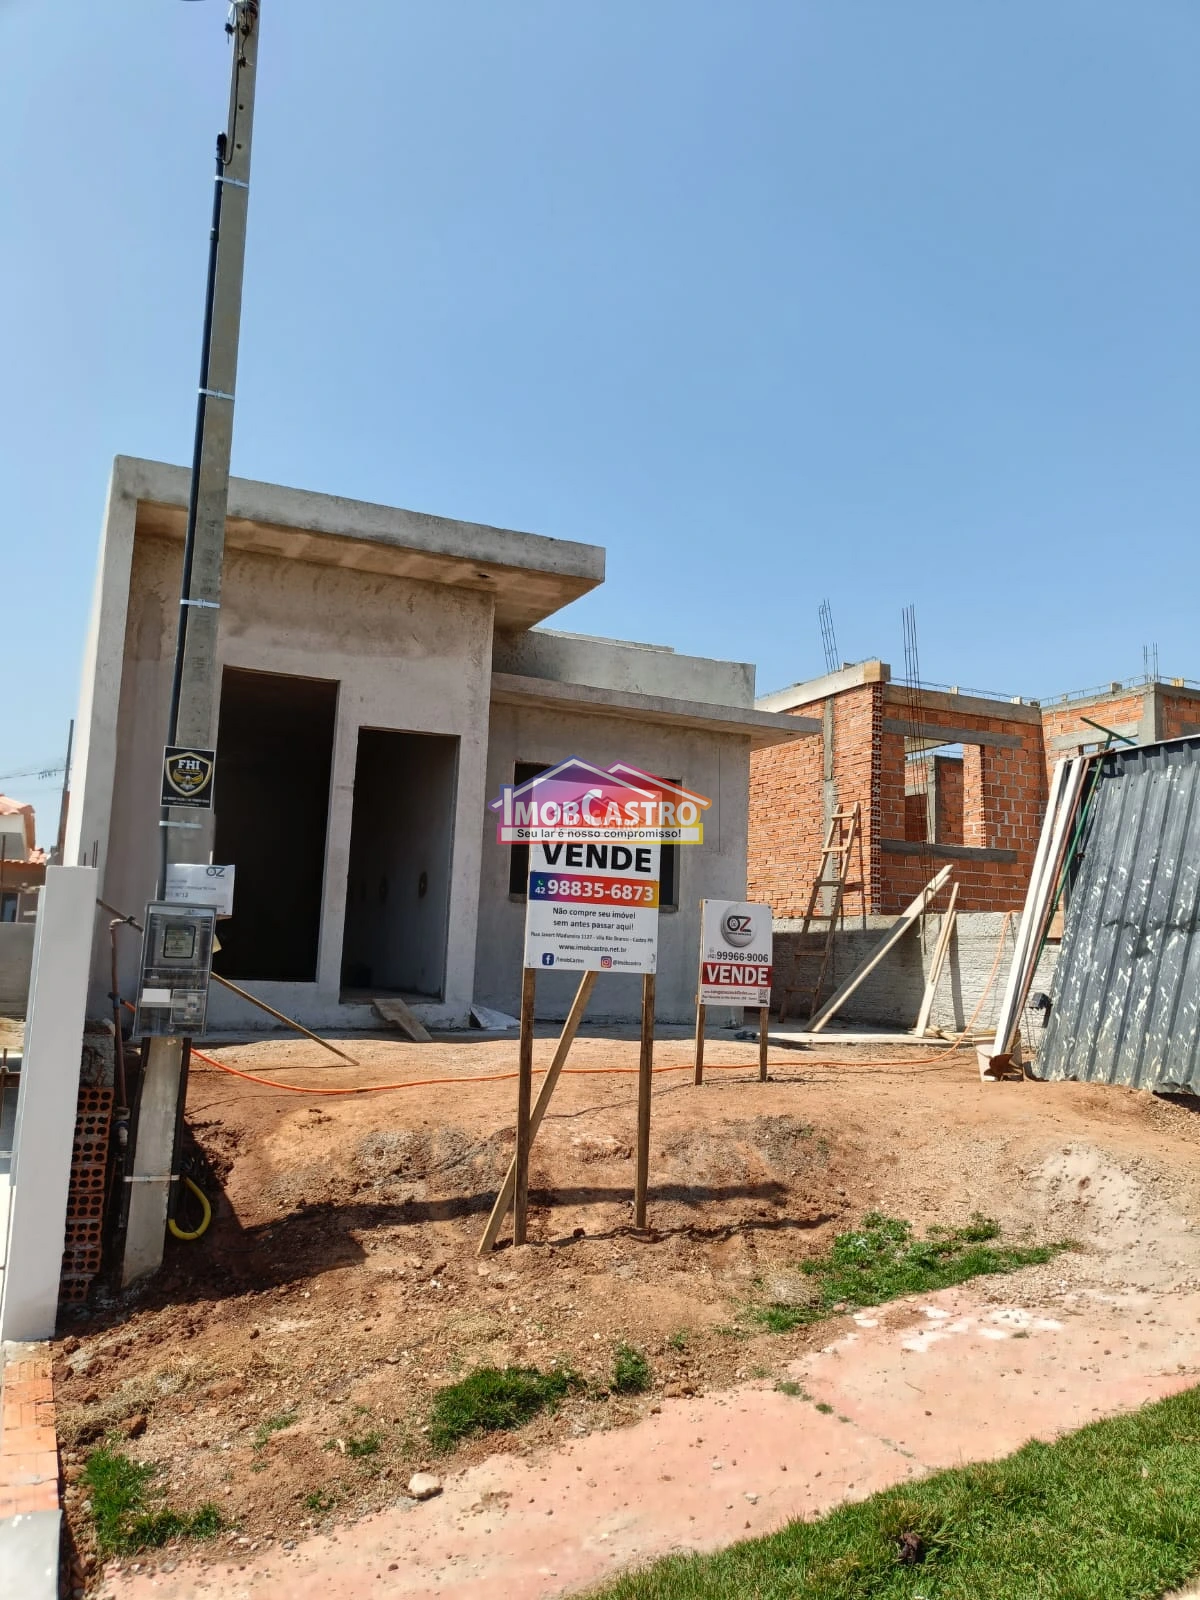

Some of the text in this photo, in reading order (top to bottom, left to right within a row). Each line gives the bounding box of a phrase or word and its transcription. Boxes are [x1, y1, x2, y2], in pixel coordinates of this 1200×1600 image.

[178, 760, 200, 770] FHI
[542, 840, 652, 872] VENDE
[534, 879, 654, 902] 42 98835-6873
[552, 907, 568, 915] Não
[569, 910, 597, 918] compre
[612, 910, 636, 920] imóvel
[616, 922, 634, 931] aqui!
[727, 915, 752, 932] OZ
[716, 951, 769, 962] 99966-9006
[706, 964, 769, 985] VENDE
